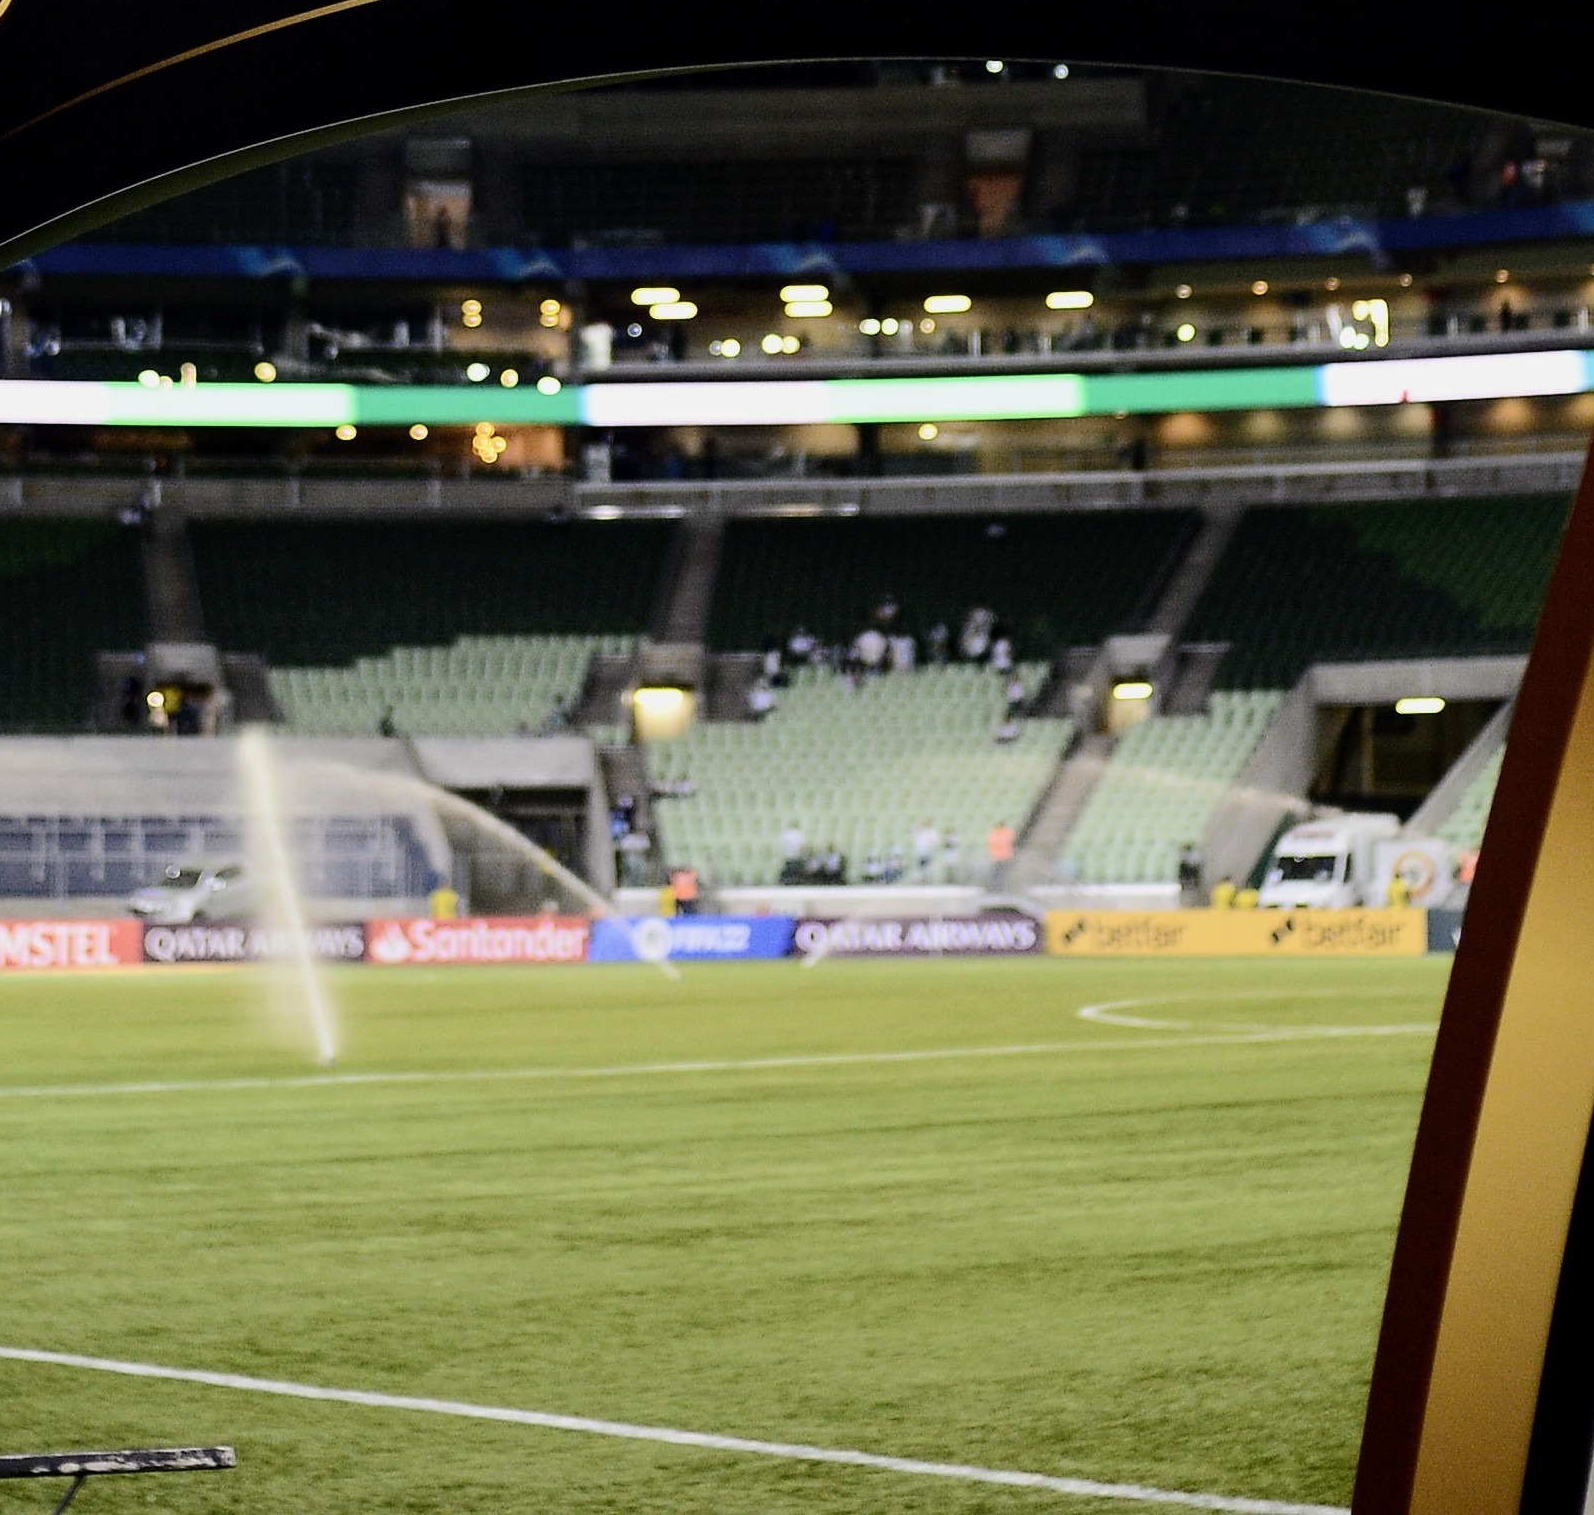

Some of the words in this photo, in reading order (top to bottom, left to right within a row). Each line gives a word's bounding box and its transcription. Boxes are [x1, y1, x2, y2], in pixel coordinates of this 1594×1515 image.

[144, 925, 247, 962] QATAR
[409, 920, 588, 960] Santander
[794, 921, 903, 954] QATAR
[905, 921, 1037, 951] AIRWAYS
[1095, 918, 1186, 948] betfair
[1306, 917, 1402, 948] betfair
